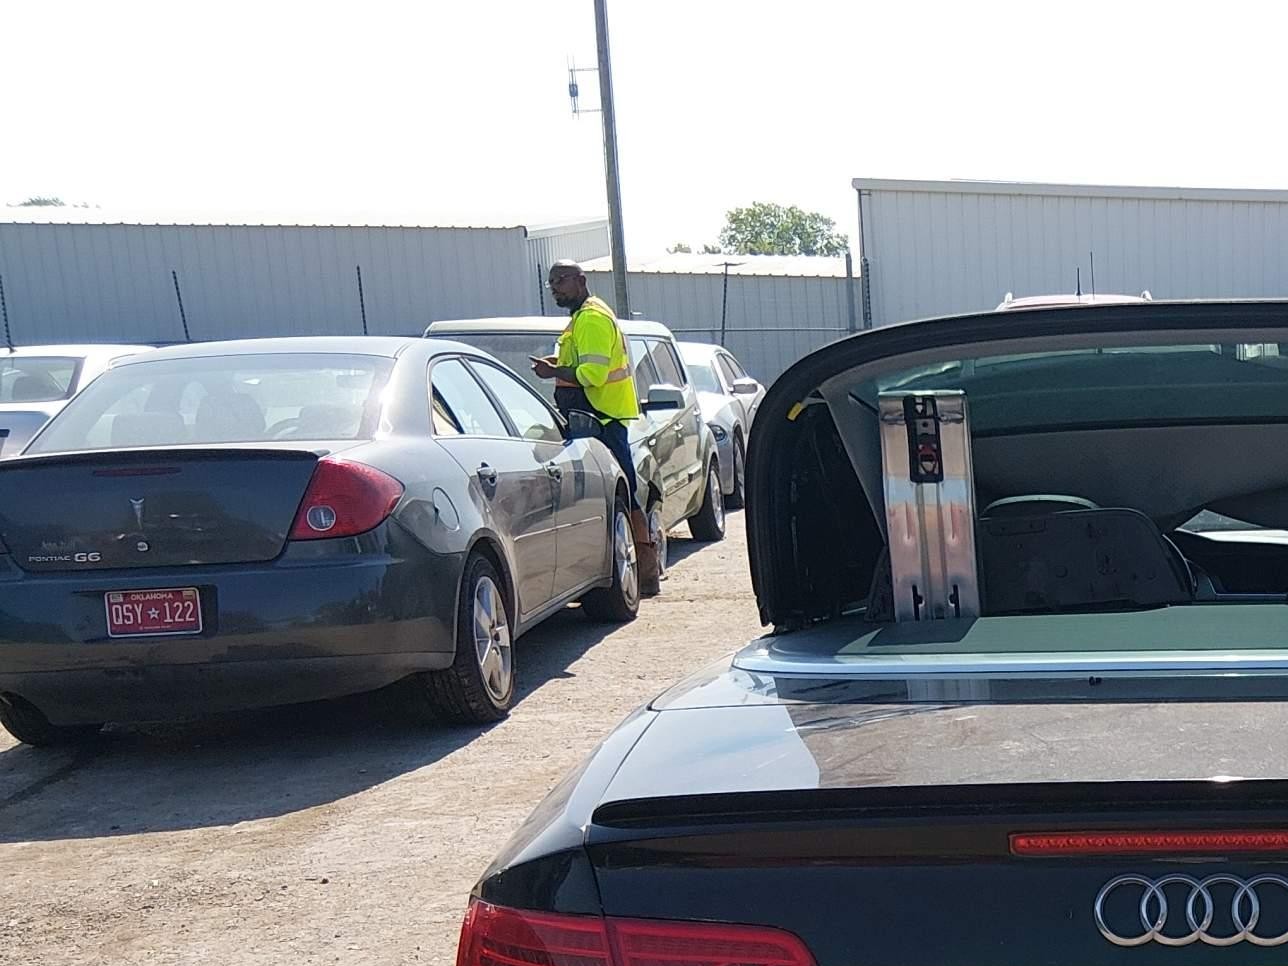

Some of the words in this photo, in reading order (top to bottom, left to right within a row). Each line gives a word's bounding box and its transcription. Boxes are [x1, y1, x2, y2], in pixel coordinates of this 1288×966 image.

[74, 552, 101, 562] G6
[130, 593, 174, 601] OKLAHOMA
[163, 601, 195, 623] 122
